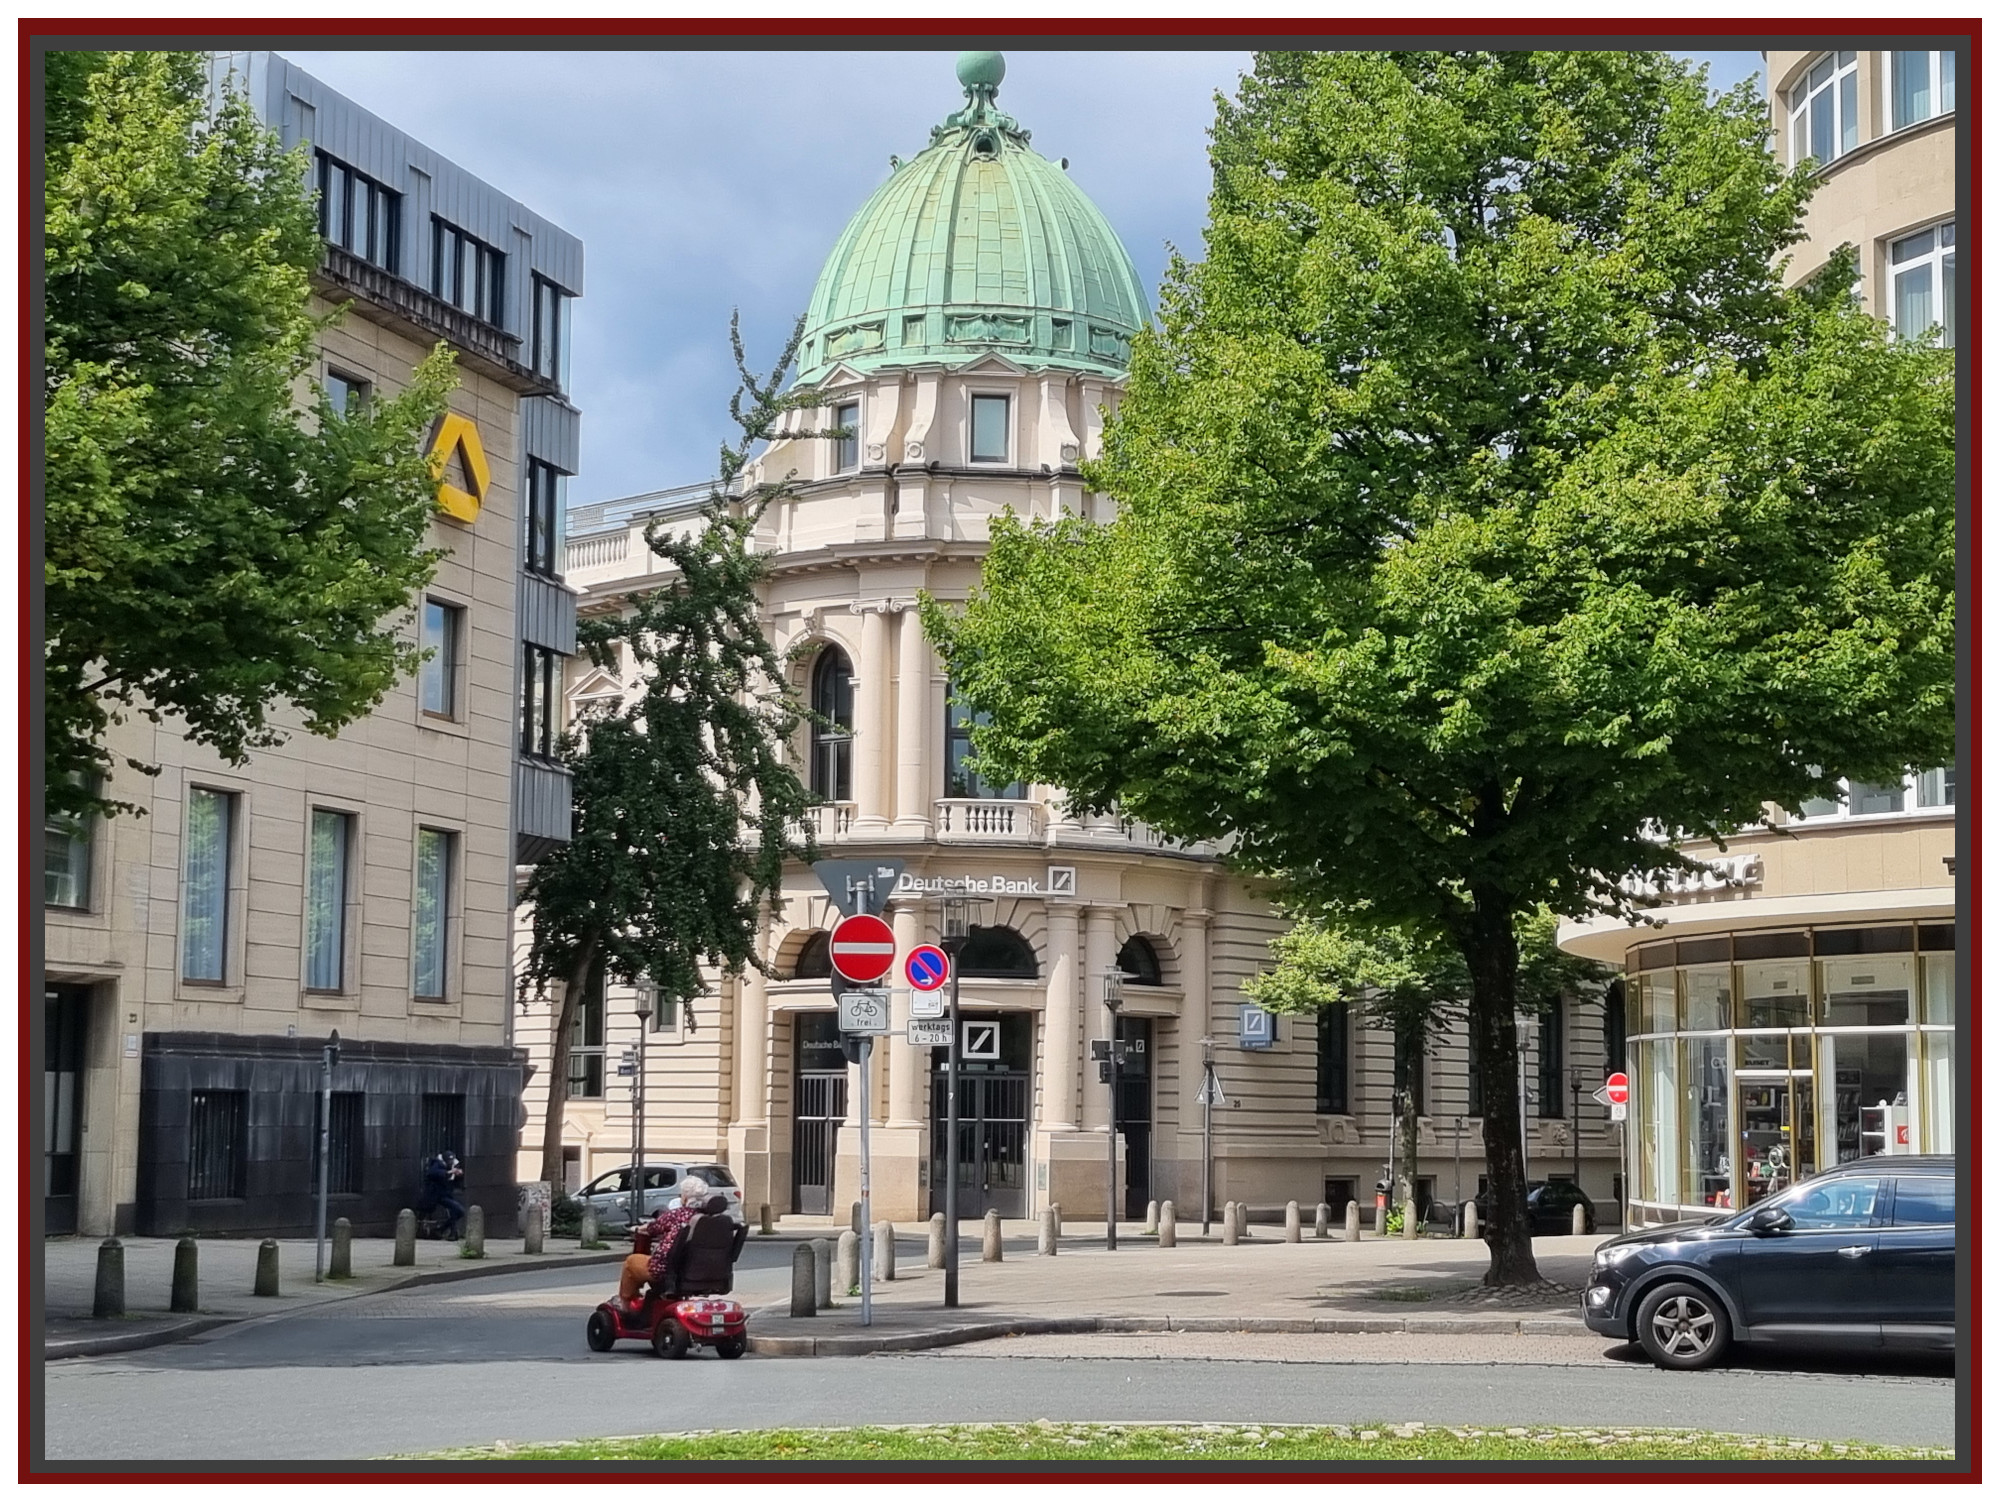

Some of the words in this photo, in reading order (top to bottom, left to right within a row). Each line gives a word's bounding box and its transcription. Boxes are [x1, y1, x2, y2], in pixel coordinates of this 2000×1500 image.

[899, 873, 988, 892] Deutsche
[992, 876, 1039, 894] Bank
[912, 1022, 950, 1032] werktags
[915, 1034, 920, 1042] 6
[930, 1034, 940, 1042] 20
[942, 1034, 947, 1042] h
